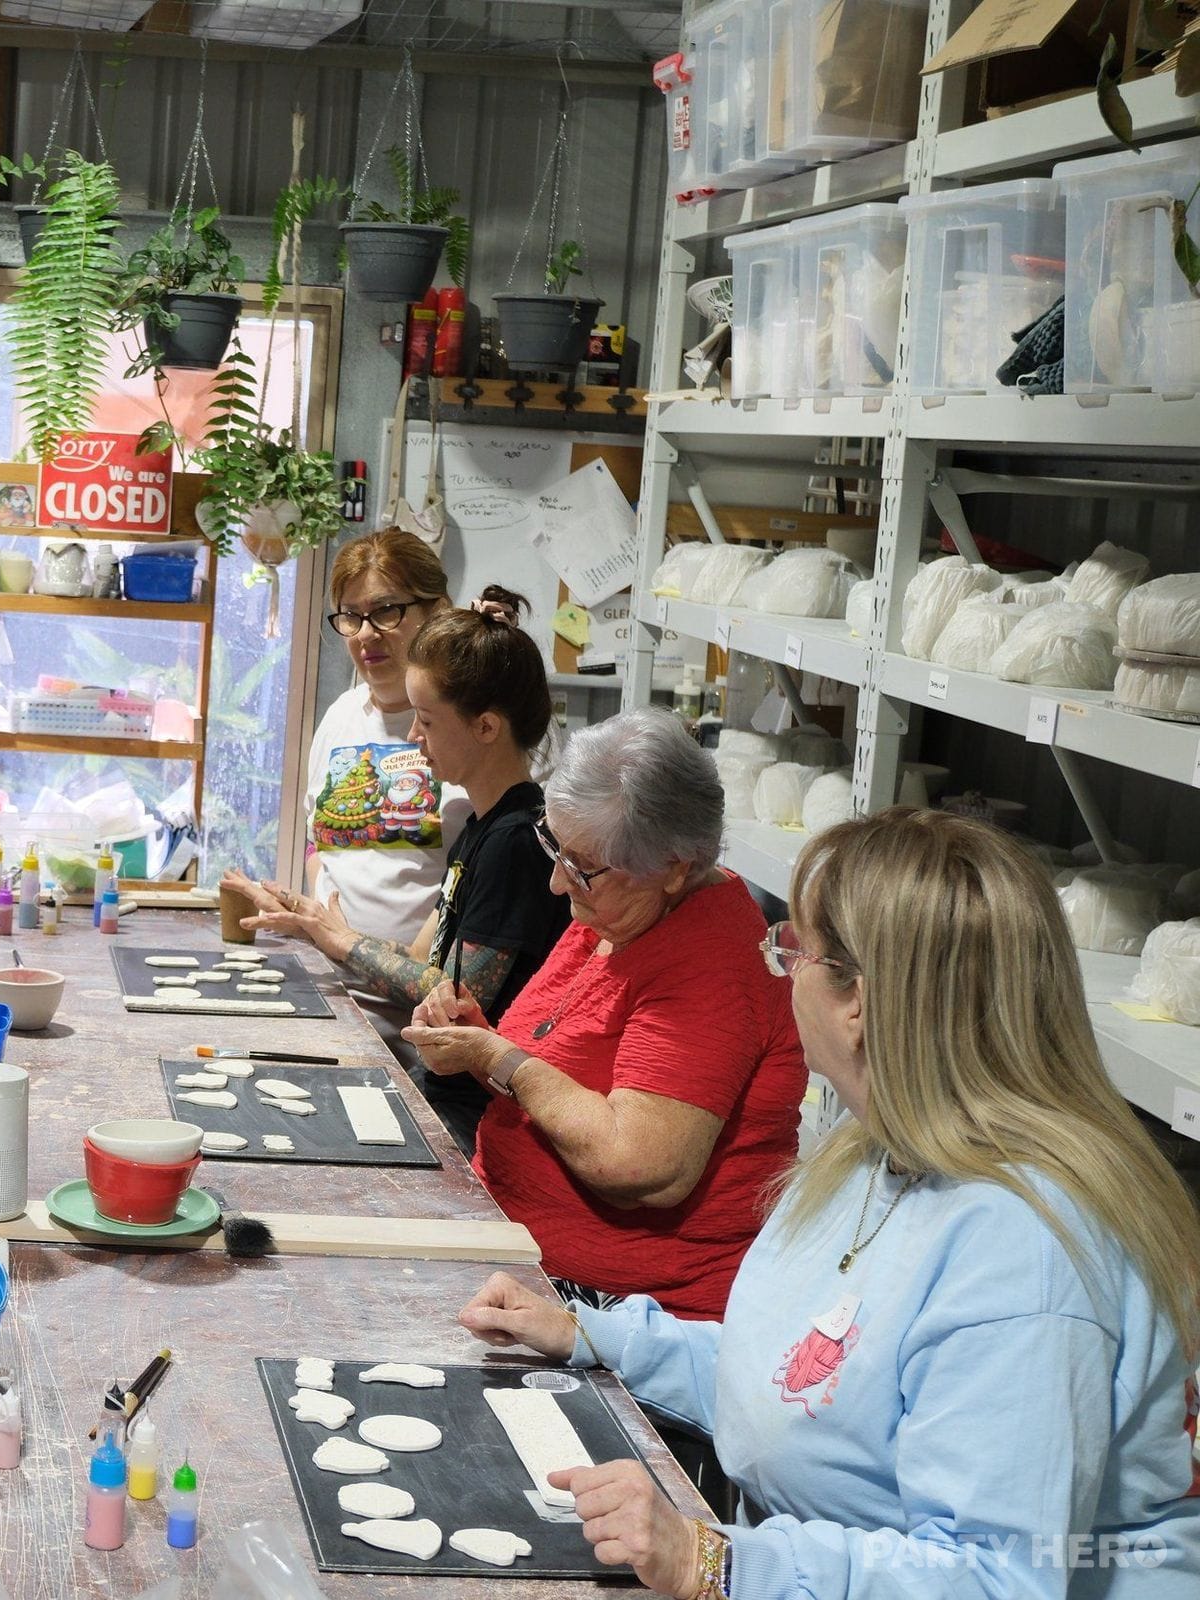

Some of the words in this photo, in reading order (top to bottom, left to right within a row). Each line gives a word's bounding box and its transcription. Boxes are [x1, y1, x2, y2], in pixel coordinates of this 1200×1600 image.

[108, 465, 134, 482] We
[138, 471, 166, 484] are
[45, 481, 166, 524] CLOSED
[390, 752, 420, 763] CHRIST
